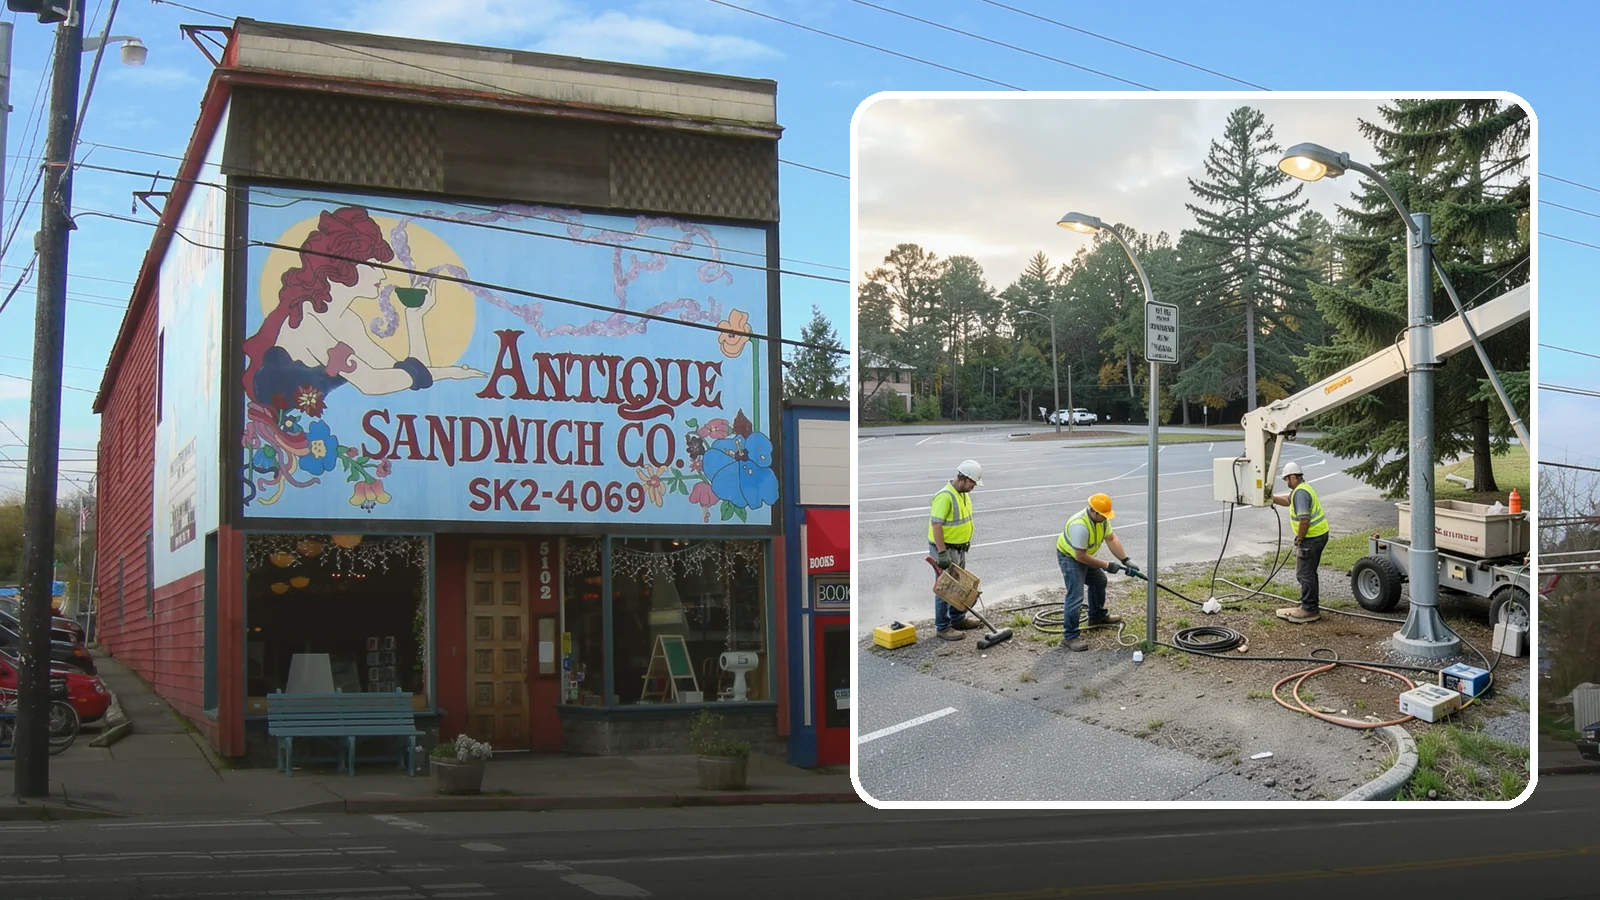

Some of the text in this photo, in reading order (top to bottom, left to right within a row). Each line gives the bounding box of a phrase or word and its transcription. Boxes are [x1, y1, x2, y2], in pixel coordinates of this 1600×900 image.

[475, 329, 723, 421] ANTIQUE
[361, 408, 685, 469] SANDWICH CO.
[468, 477, 646, 513] SK2-4069
[540, 542, 551, 599] 5102
[809, 555, 835, 569] BOOKS
